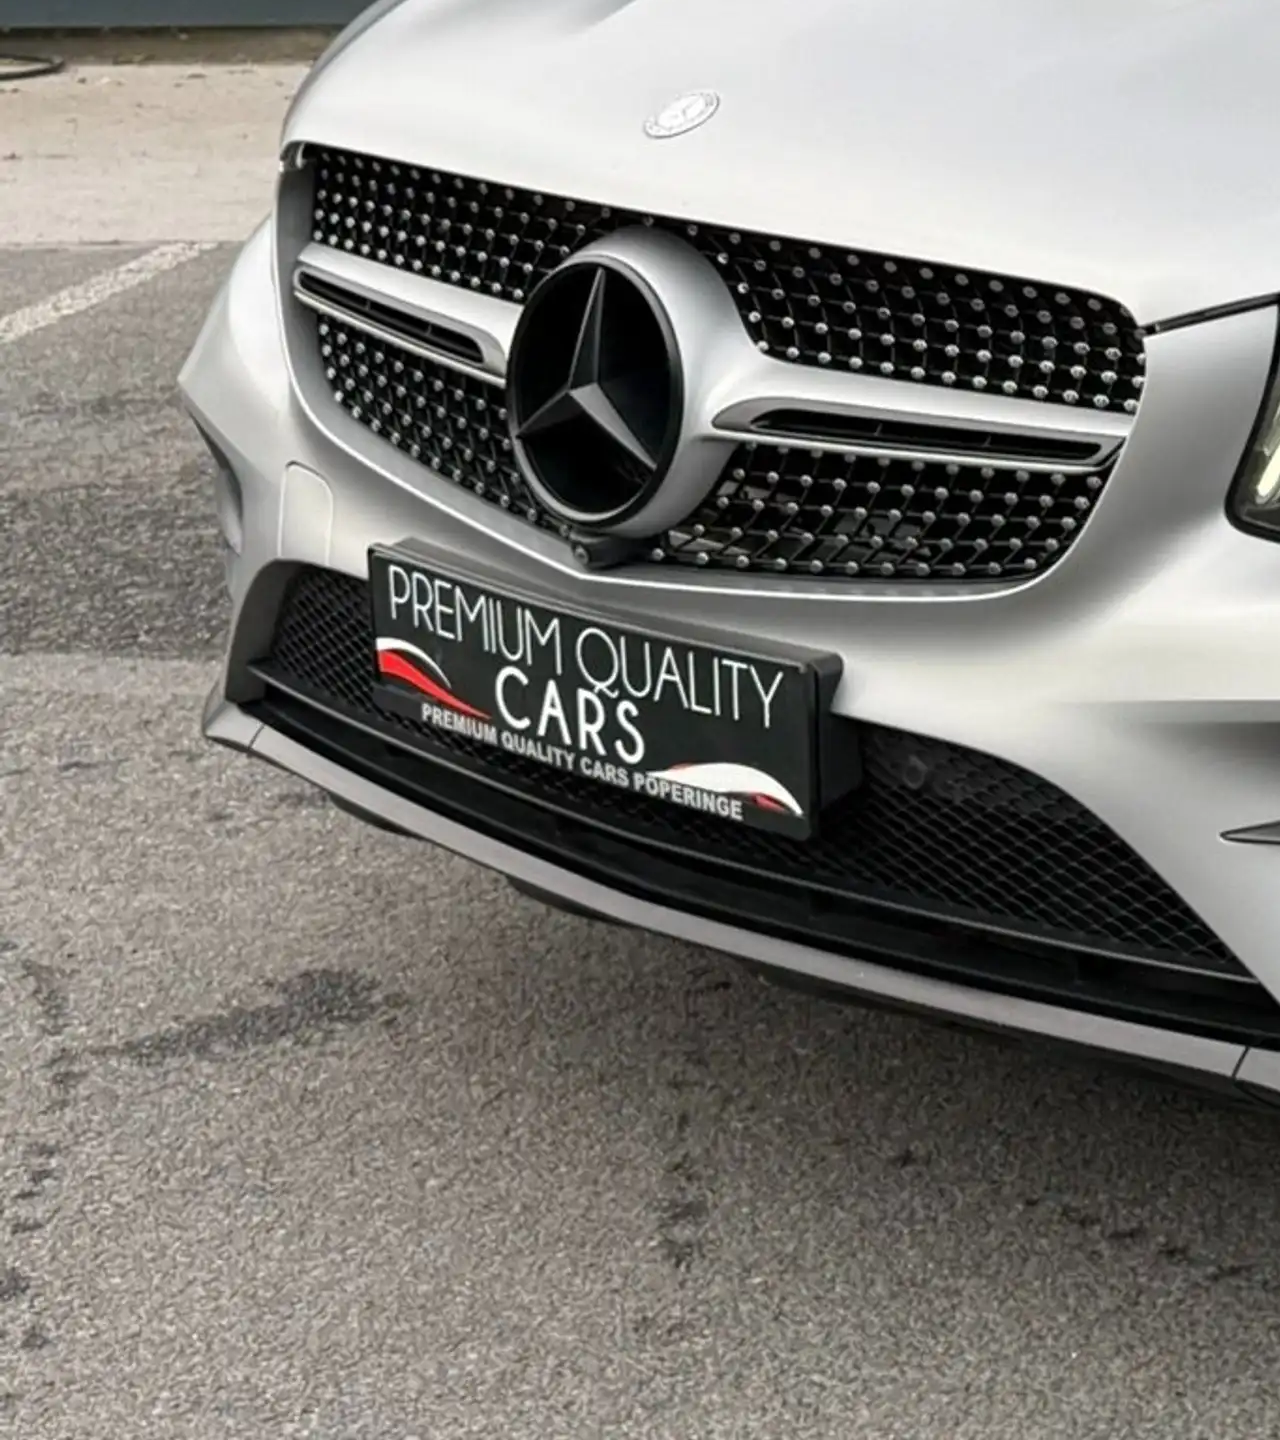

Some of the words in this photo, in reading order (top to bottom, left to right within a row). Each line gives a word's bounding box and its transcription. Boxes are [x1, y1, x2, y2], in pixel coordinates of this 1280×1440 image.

[388, 564, 562, 676] PREMIUM
[576, 626, 784, 729] QUALITY
[421, 702, 498, 745] PREMIUM
[501, 730, 575, 770] QUALITY
[579, 756, 630, 787] CARS
[632, 771, 744, 823] POPERINGE
[495, 666, 645, 764] CARS
